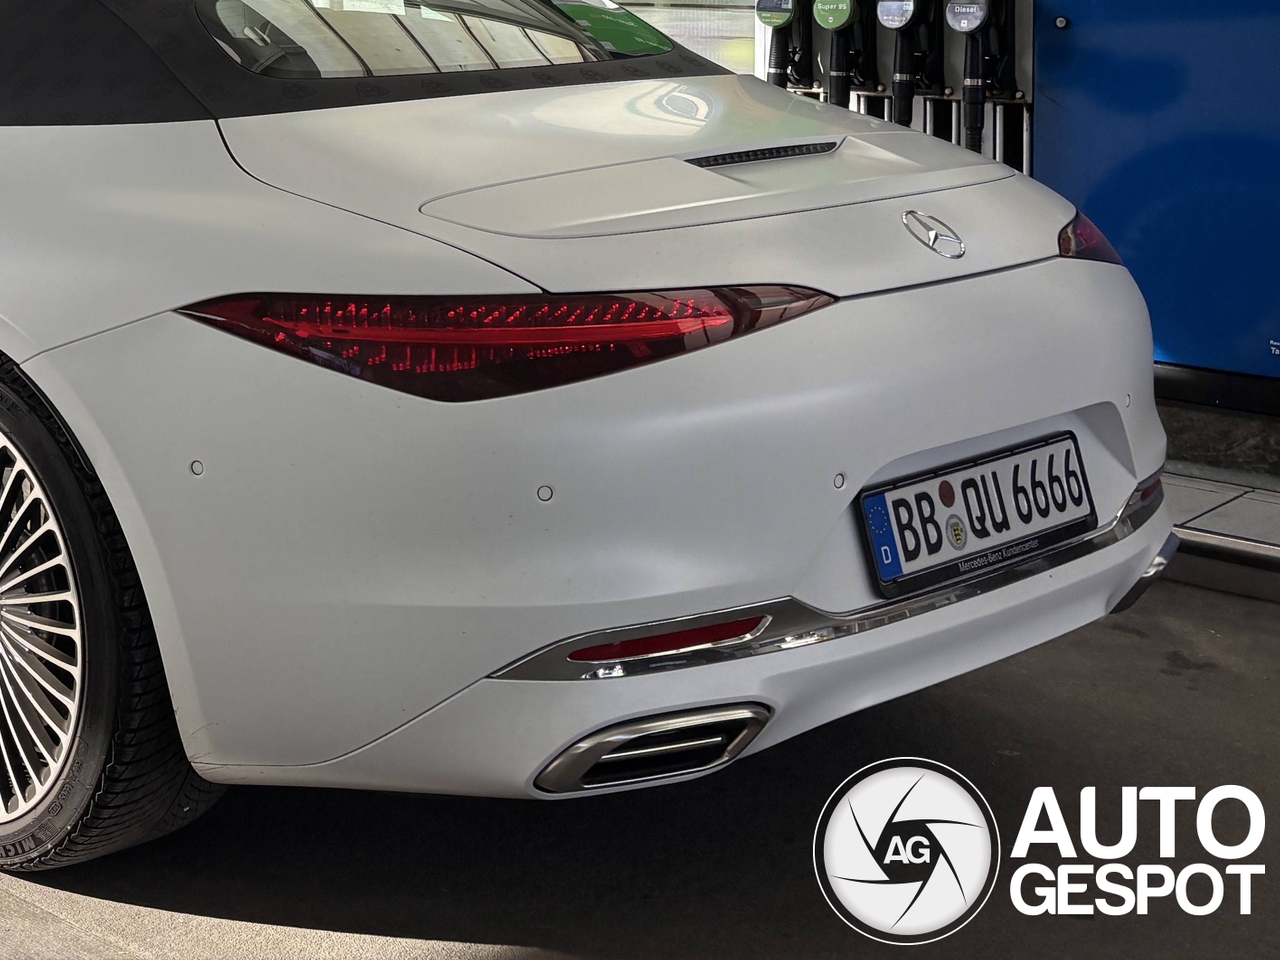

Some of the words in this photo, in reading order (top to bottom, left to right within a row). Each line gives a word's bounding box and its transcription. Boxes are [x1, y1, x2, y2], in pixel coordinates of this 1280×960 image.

[817, 3, 837, 11] Super
[892, 492, 943, 562] BB
[960, 470, 1011, 539] QU
[1012, 449, 1083, 525] 6666
[880, 545, 892, 565] D
[959, 551, 1002, 572] Mercedes-Benz
[1002, 539, 1039, 559] Kundencenter
